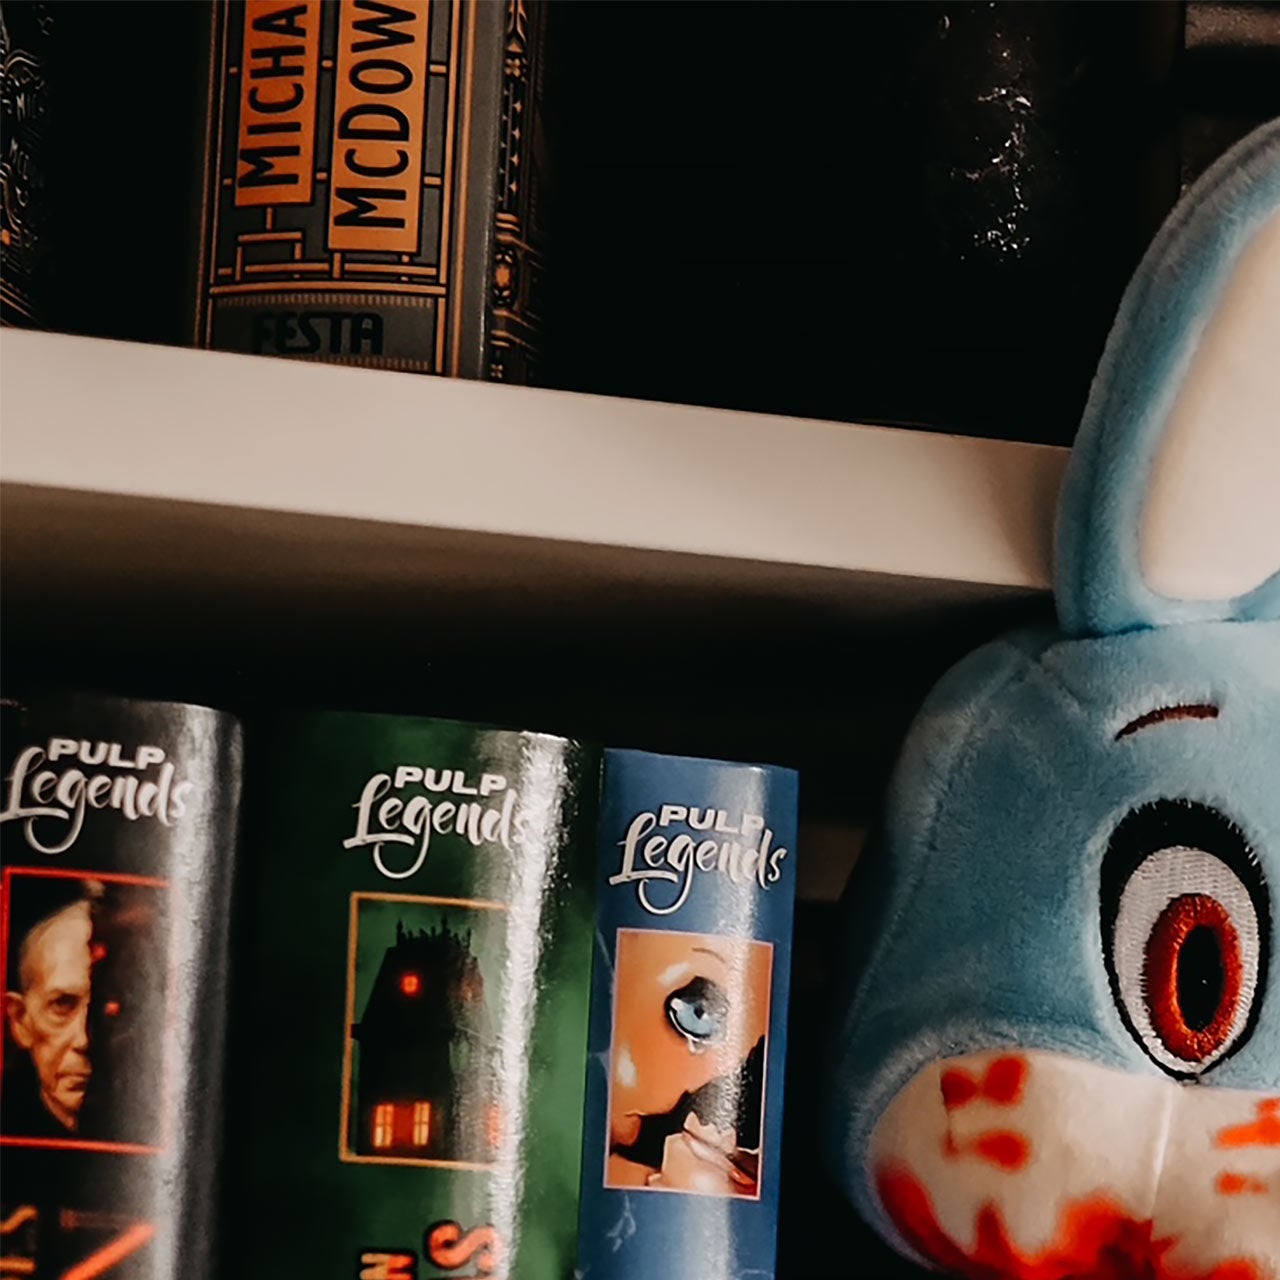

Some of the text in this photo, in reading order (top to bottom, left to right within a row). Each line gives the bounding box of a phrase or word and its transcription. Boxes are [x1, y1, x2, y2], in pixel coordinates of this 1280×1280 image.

[253, 310, 383, 356] FESTA
[47, 737, 166, 770] PULP
[0, 745, 197, 855] Legends
[394, 765, 507, 797] PULP
[343, 773, 531, 879] Legends
[659, 804, 765, 836] PULP
[608, 812, 788, 915] Legends
